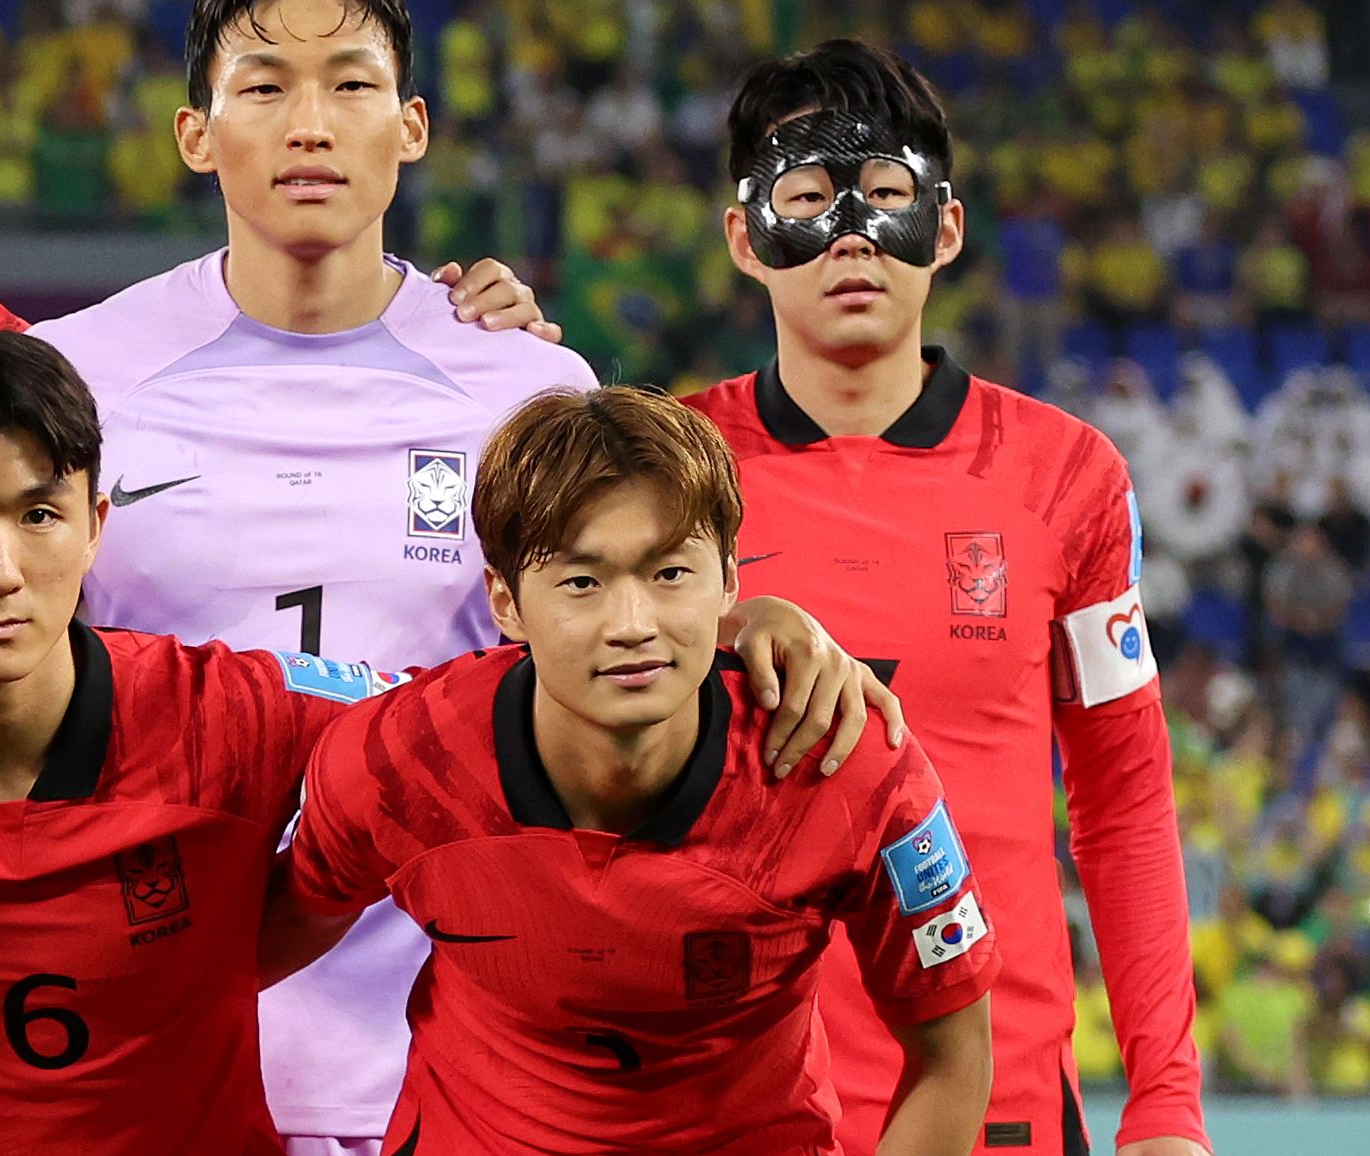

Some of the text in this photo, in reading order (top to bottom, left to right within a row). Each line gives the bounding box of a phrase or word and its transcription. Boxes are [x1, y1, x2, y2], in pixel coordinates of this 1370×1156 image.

[403, 544, 462, 565] KOREA
[275, 585, 322, 656] 1
[949, 624, 1007, 642] KOREA
[917, 855, 949, 882] UNITES
[130, 918, 192, 947] KOREA
[3, 973, 90, 1070] 6
